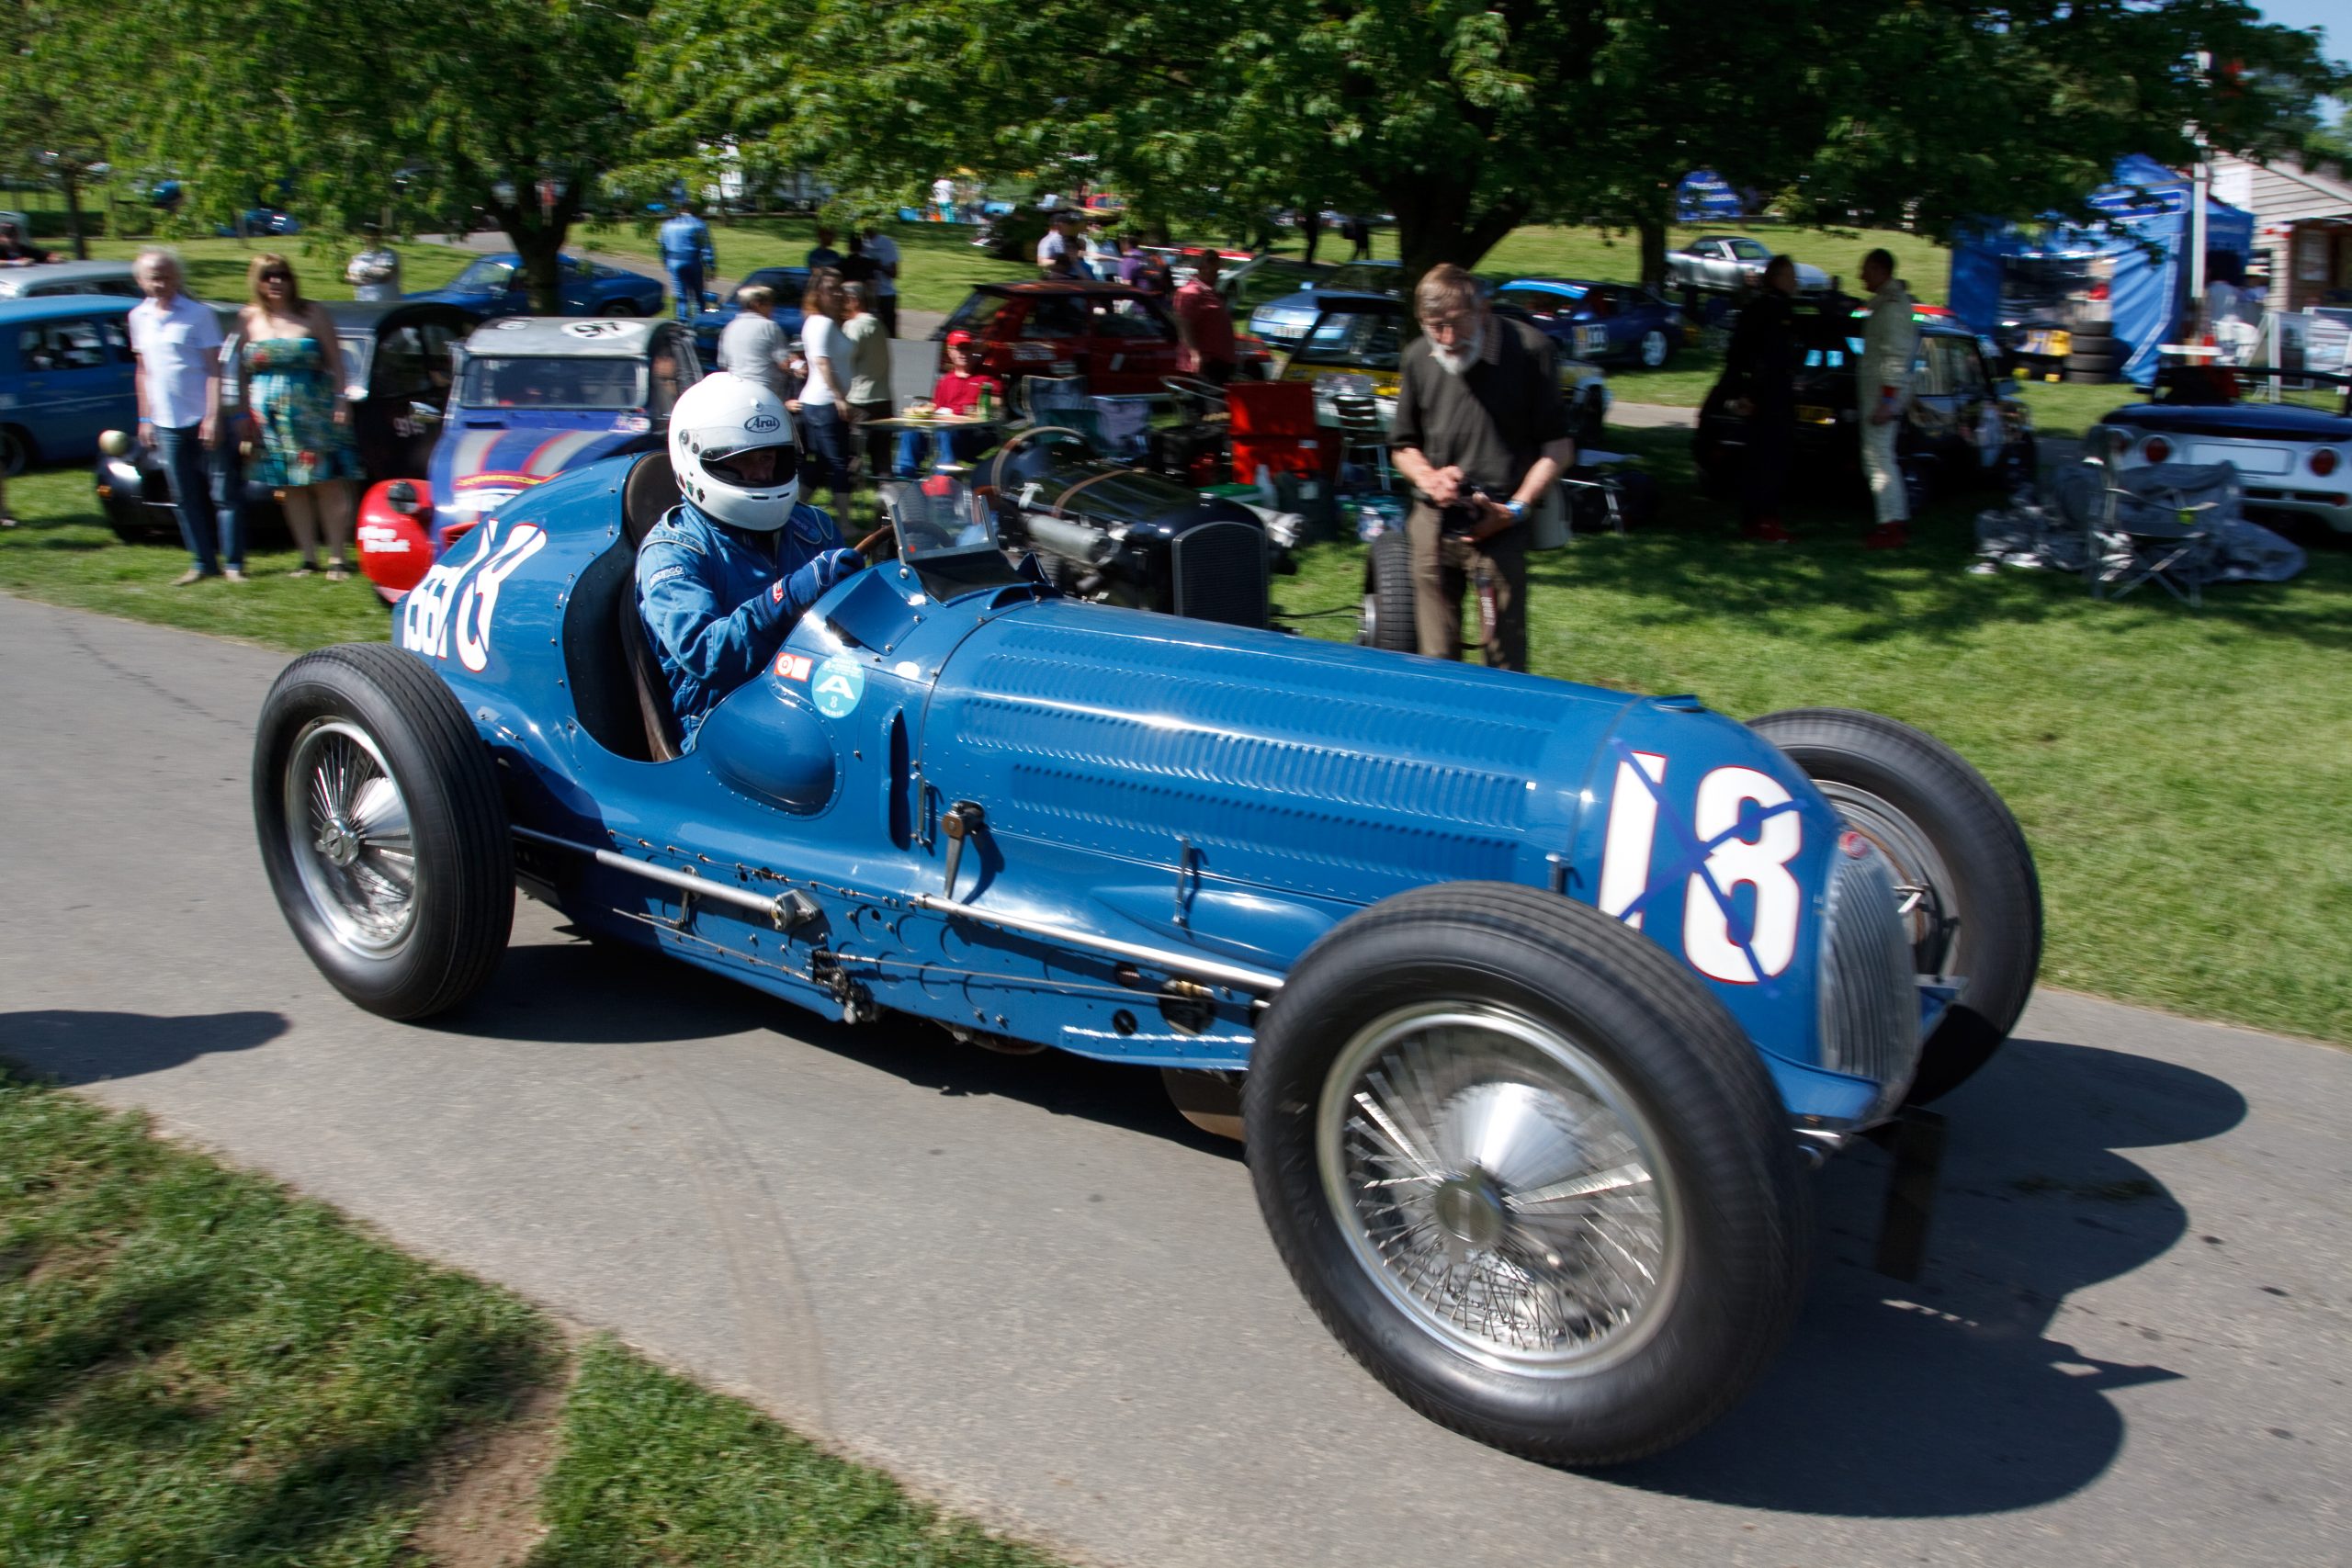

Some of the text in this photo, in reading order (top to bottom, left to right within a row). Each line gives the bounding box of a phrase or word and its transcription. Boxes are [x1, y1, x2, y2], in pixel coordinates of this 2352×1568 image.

[747, 417, 777, 429] Arai
[815, 674, 855, 700] A
[1599, 750, 1802, 985] 18
